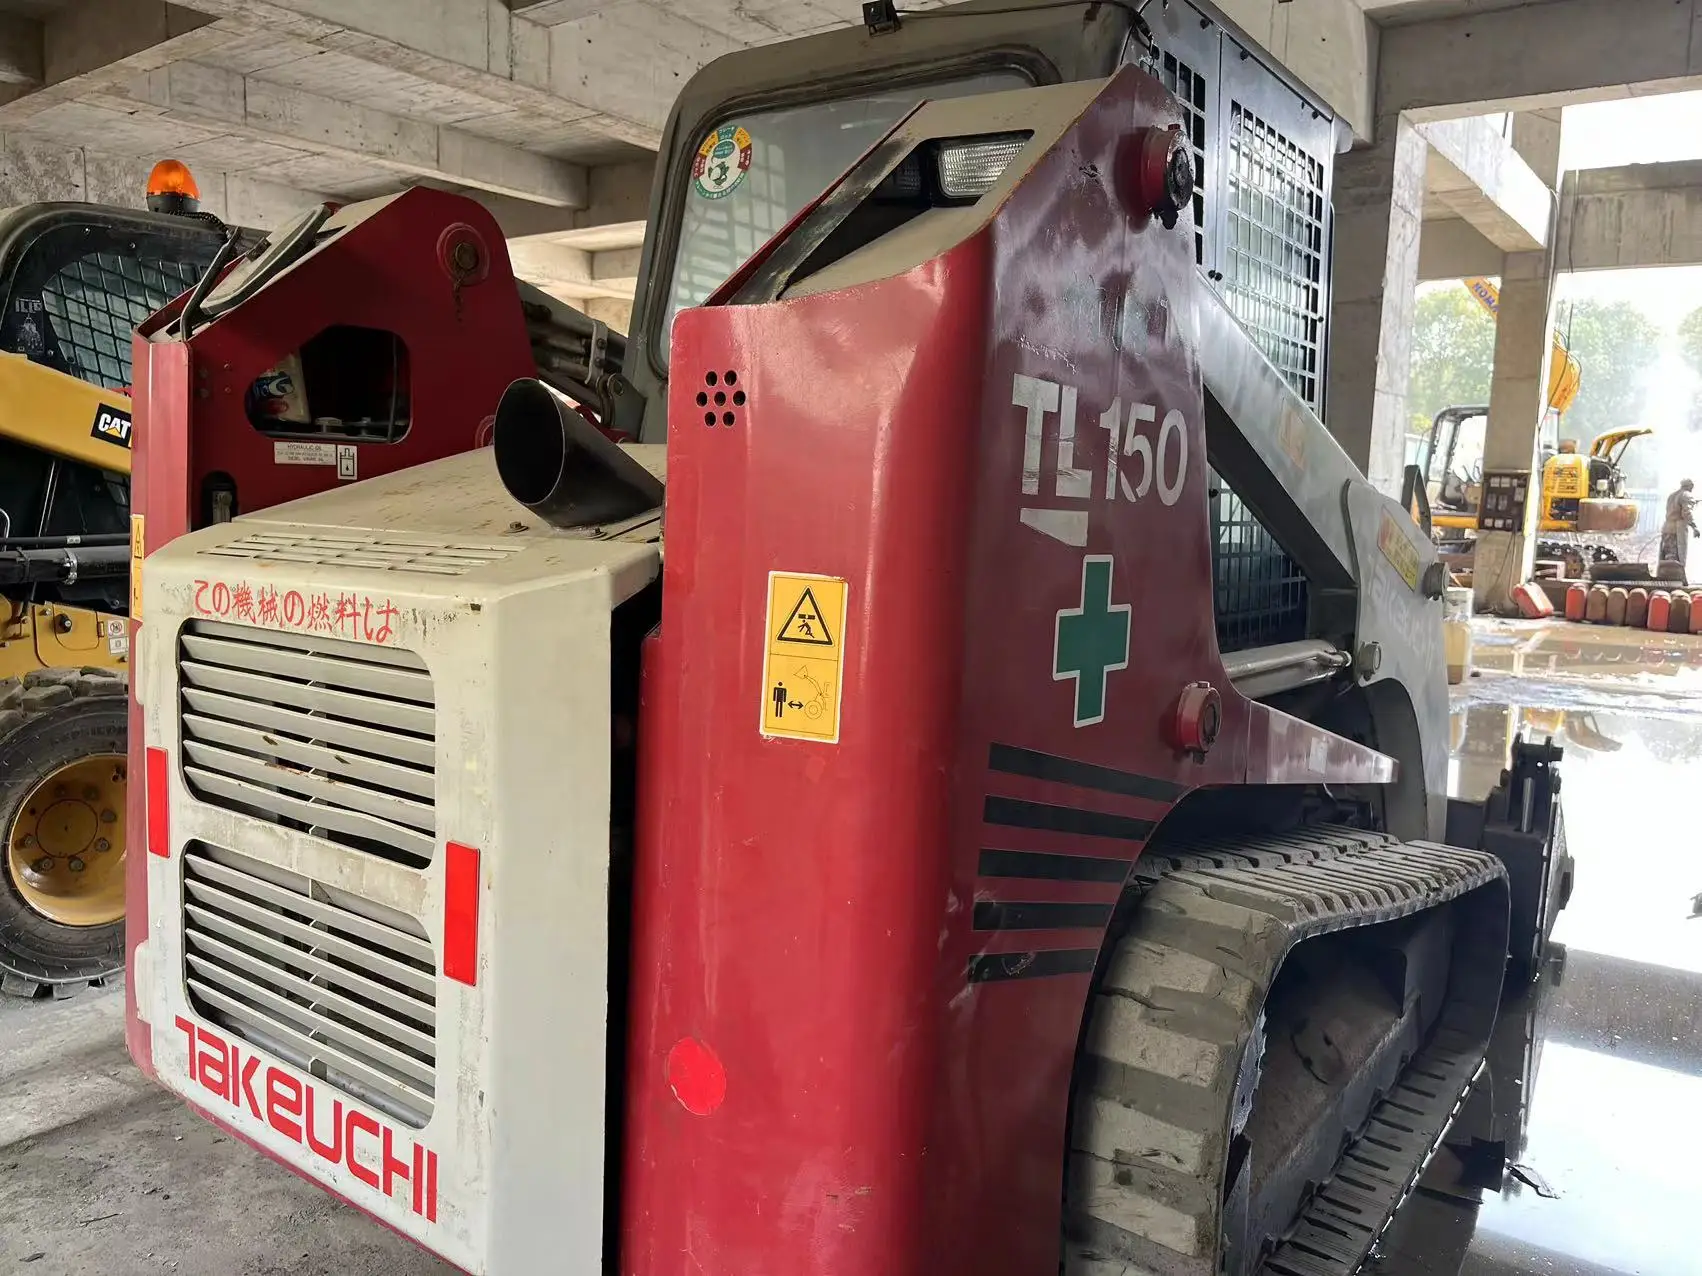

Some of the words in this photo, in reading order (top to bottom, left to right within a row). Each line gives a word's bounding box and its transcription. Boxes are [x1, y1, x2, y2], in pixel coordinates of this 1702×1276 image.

[98, 413, 131, 440] CAT
[194, 580, 400, 643] この機械の燃料は
